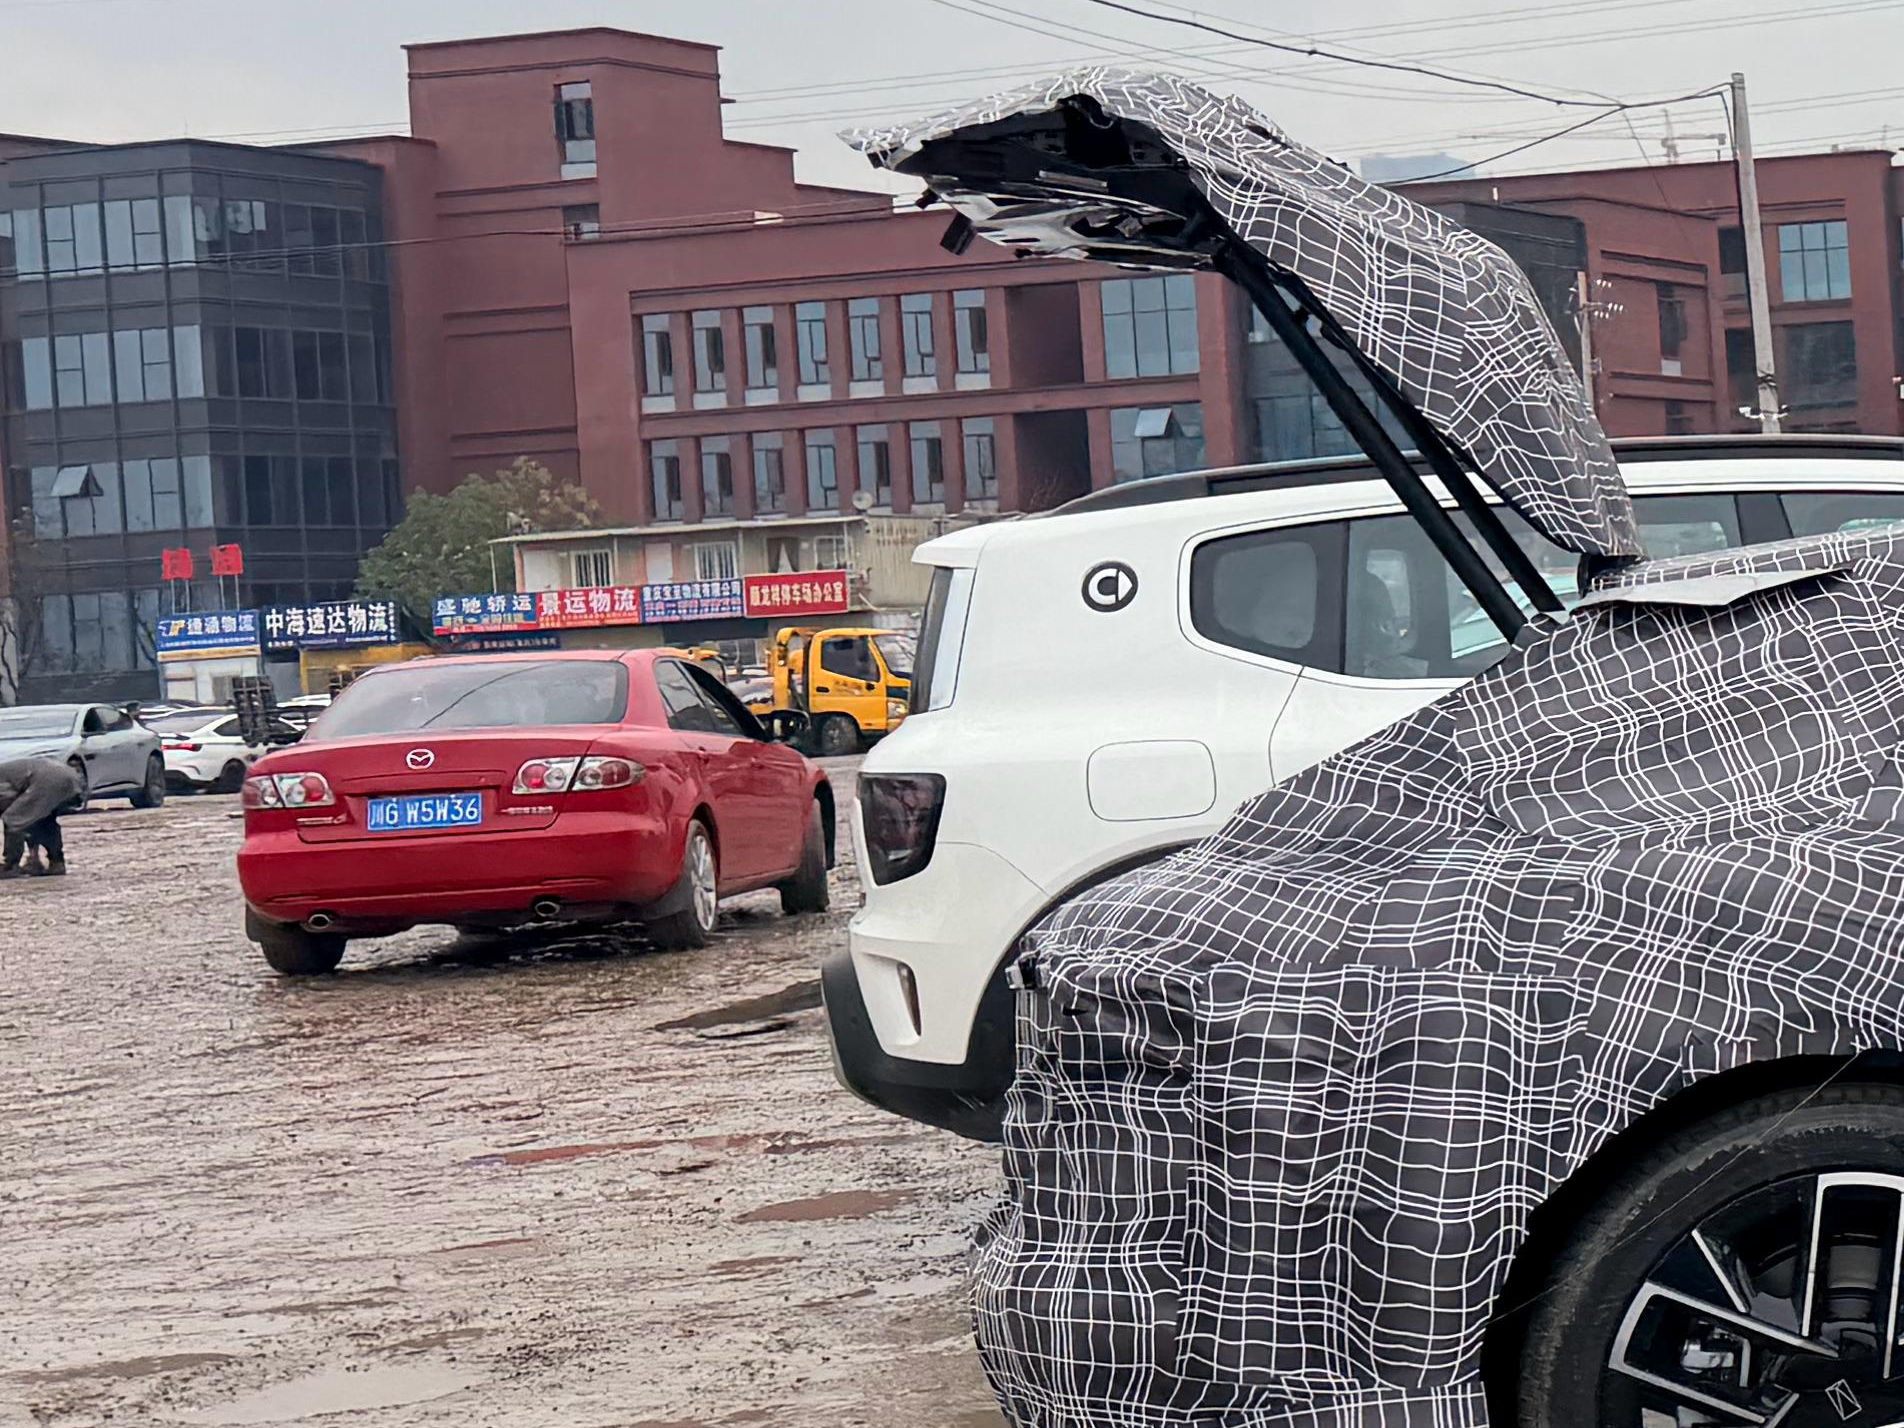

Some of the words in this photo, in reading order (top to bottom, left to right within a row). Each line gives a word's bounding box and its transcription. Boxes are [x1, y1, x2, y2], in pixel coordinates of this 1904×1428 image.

[541, 588, 637, 616] 景运物流
[265, 603, 388, 638] 中海速达物流
[406, 797, 479, 824] W5W36
